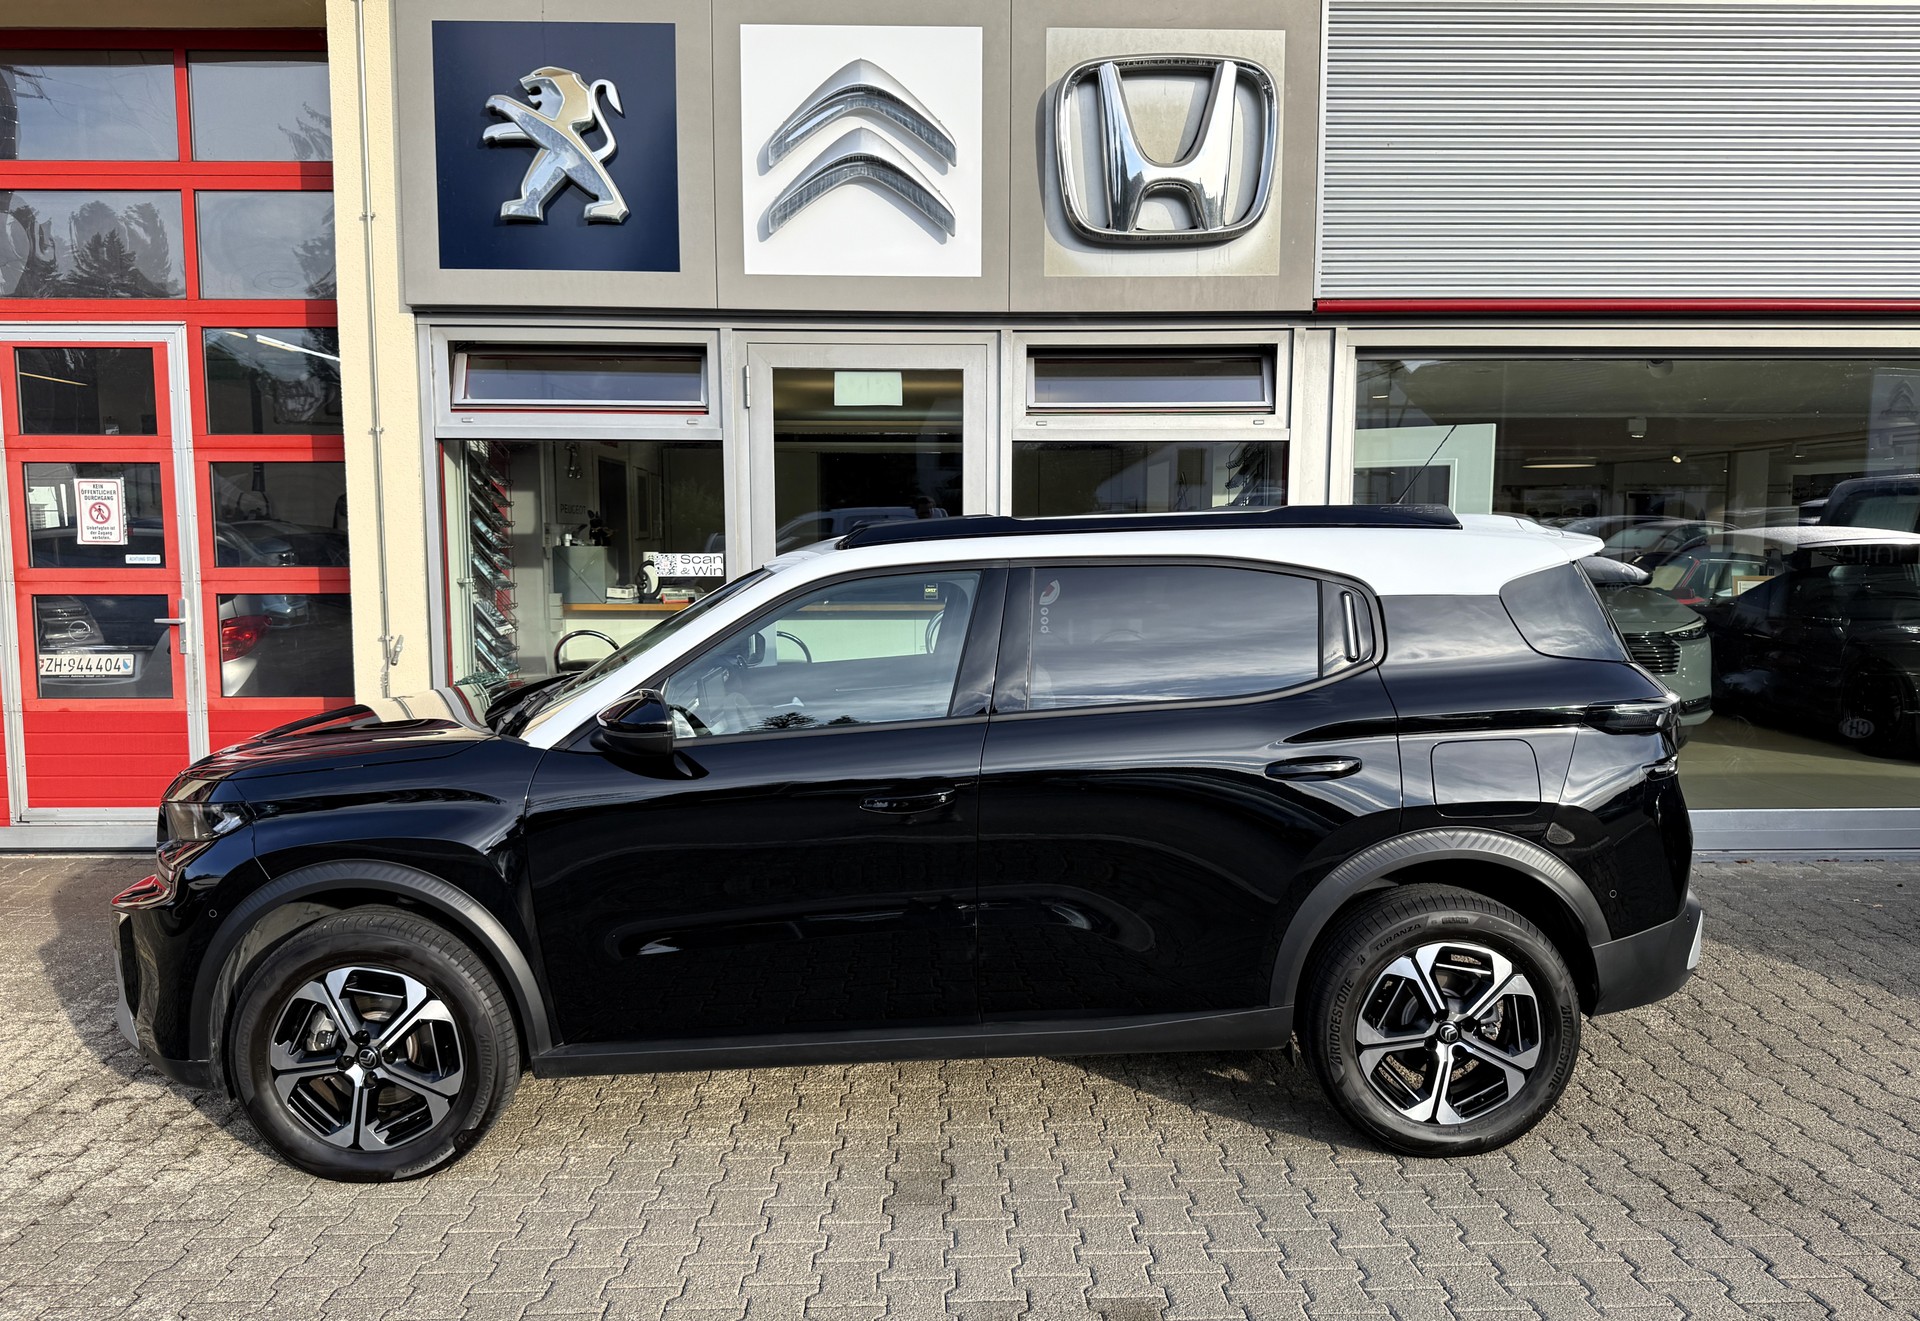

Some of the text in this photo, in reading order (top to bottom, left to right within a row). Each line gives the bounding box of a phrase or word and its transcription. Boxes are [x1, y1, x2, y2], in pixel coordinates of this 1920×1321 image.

[680, 554, 724, 565] Scan
[680, 564, 725, 576] & Win
[1374, 923, 1422, 951] TURANZA
[1328, 977, 1355, 1066] BRIDGESTONE
[1547, 1005, 1573, 1090] BRIDGESTONE
